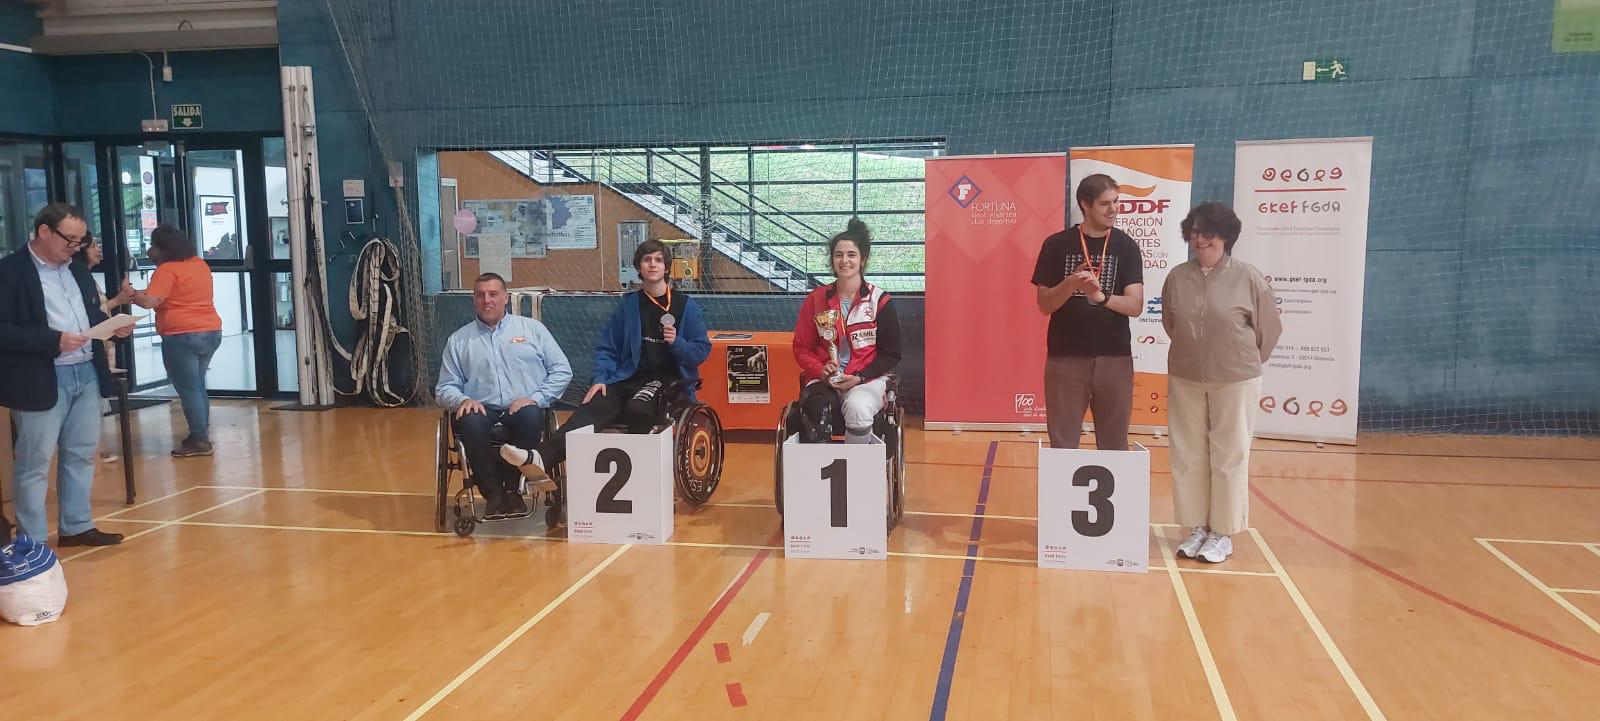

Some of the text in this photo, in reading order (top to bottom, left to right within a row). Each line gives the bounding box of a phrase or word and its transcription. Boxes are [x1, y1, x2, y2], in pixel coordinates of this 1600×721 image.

[173, 107, 201, 116] SALIDA
[958, 184, 972, 201] F
[971, 202, 1017, 211] FORTUNA
[1118, 199, 1170, 214] DDF
[1115, 215, 1163, 227] ERACIÓN
[1122, 226, 1158, 237] ÑOLA
[1134, 239, 1161, 247] RTES
[1143, 260, 1167, 269] DAD
[594, 448, 632, 513] 2
[821, 458, 848, 528] 1
[1071, 465, 1115, 537] 3
